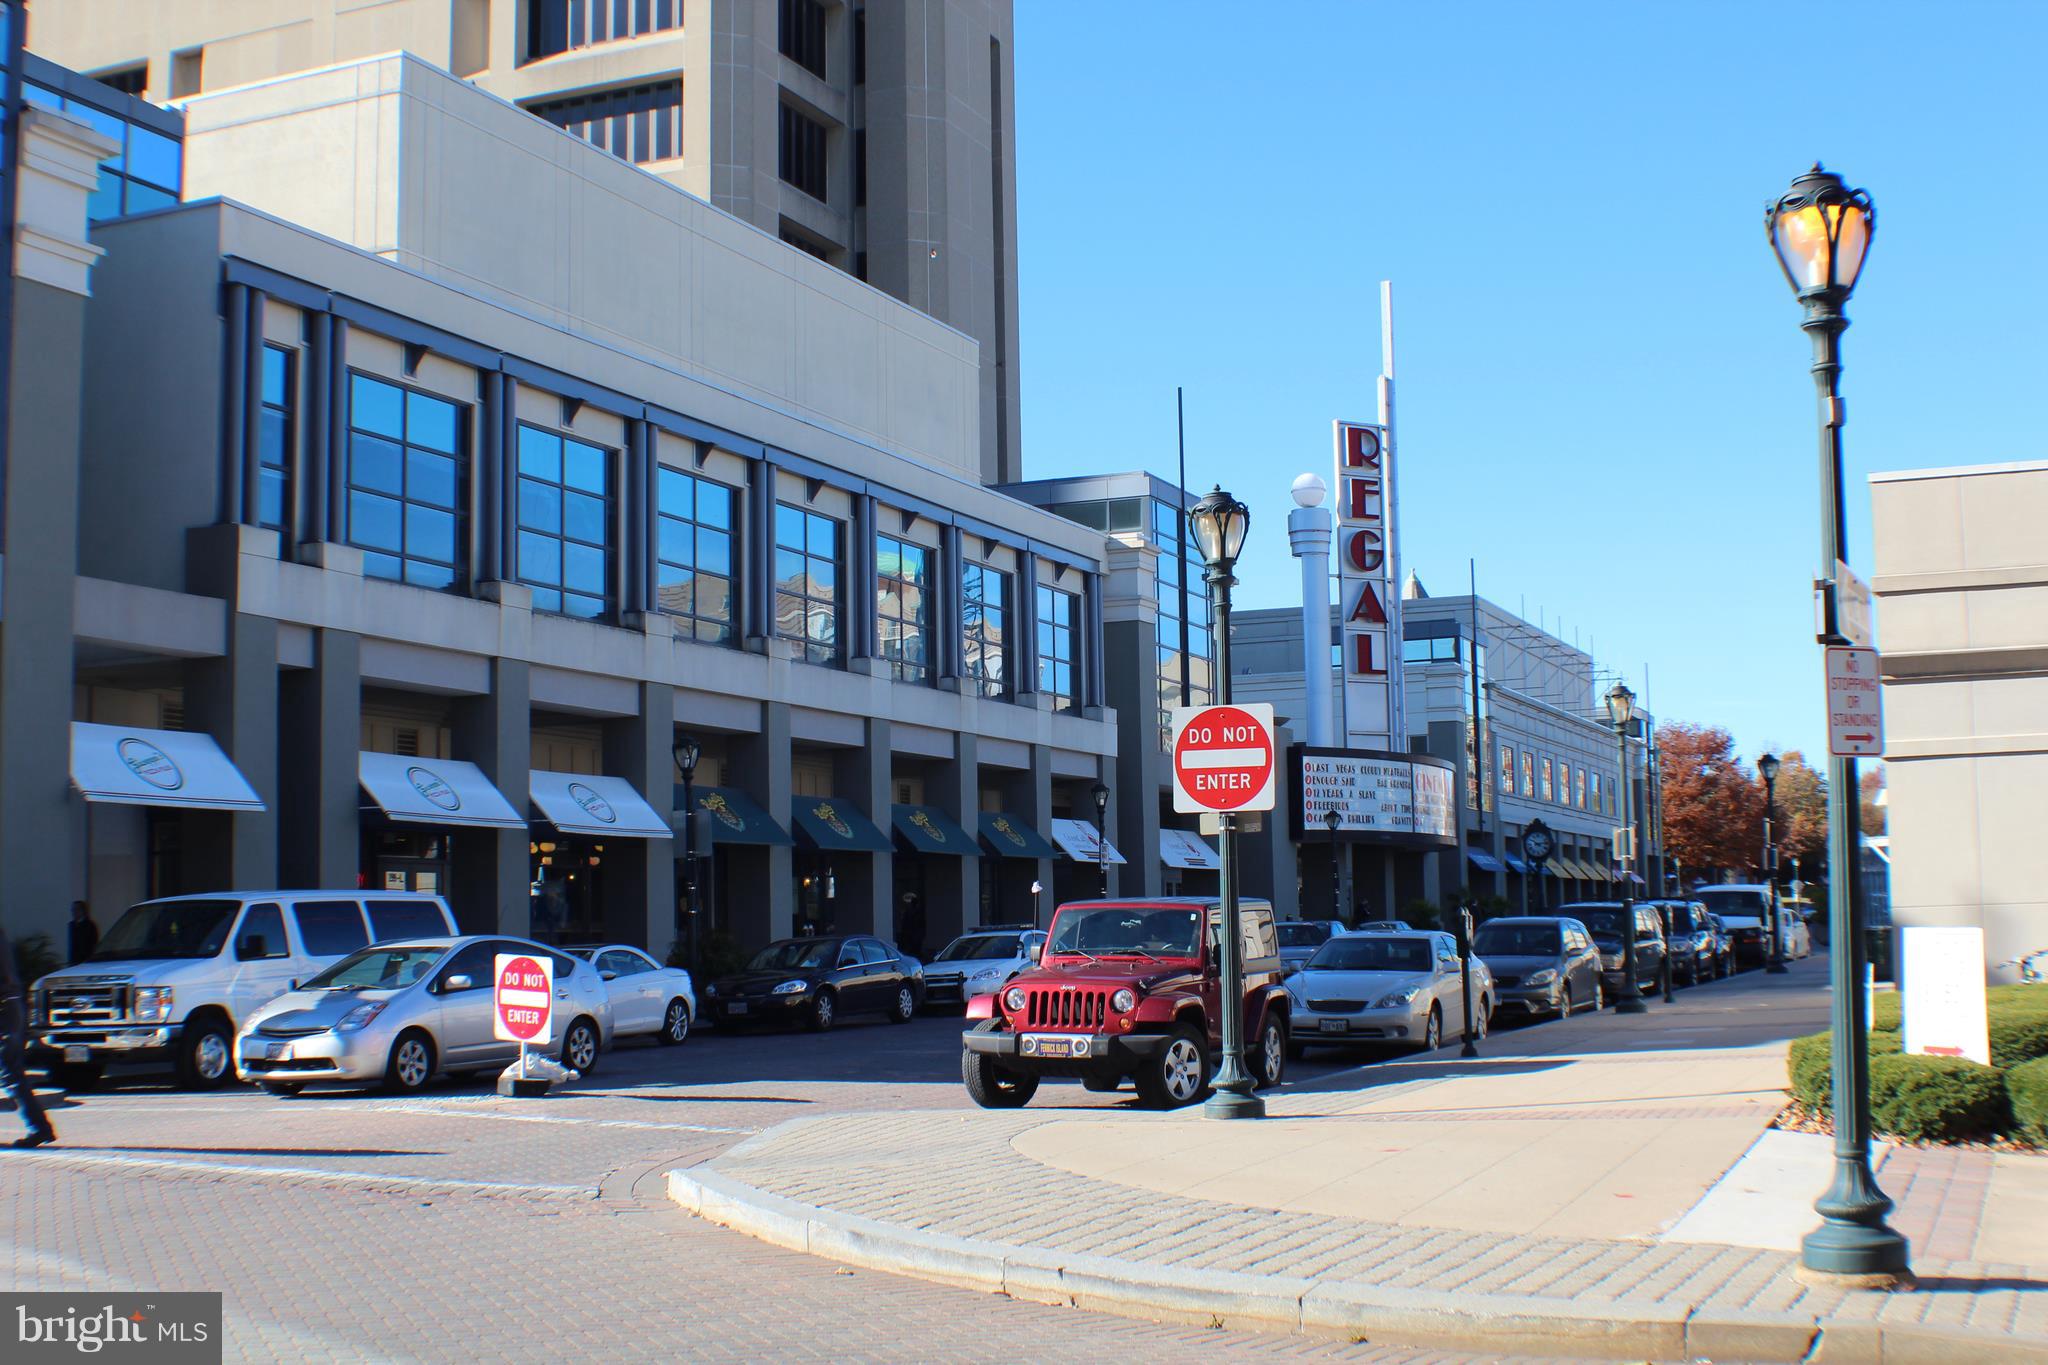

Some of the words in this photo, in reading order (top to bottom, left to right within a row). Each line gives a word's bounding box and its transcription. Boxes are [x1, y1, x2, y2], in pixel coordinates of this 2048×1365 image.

[1346, 427, 1388, 675] REGAL
[1846, 660, 1860, 673] NO
[1831, 677, 1876, 692] STOPPING
[1847, 695, 1860, 709] OR
[1833, 713, 1878, 727] STANDING
[1189, 728, 1212, 744] DO
[1223, 726, 1257, 743] NOT
[1312, 763, 1329, 773] LAST
[1336, 764, 1356, 775] VEGAS
[1196, 773, 1251, 790] ENTER
[1312, 776, 1339, 786] ENOUGH
[1313, 789, 1320, 798] 12
[1322, 789, 1344, 799] YEARS
[1348, 790, 1353, 799] A
[1358, 790, 1376, 800] SLAVE
[504, 972, 519, 986] DO
[523, 973, 545, 988] NOT
[1060, 984, 1076, 992] Jeep
[508, 1009, 540, 1025] ENTER
